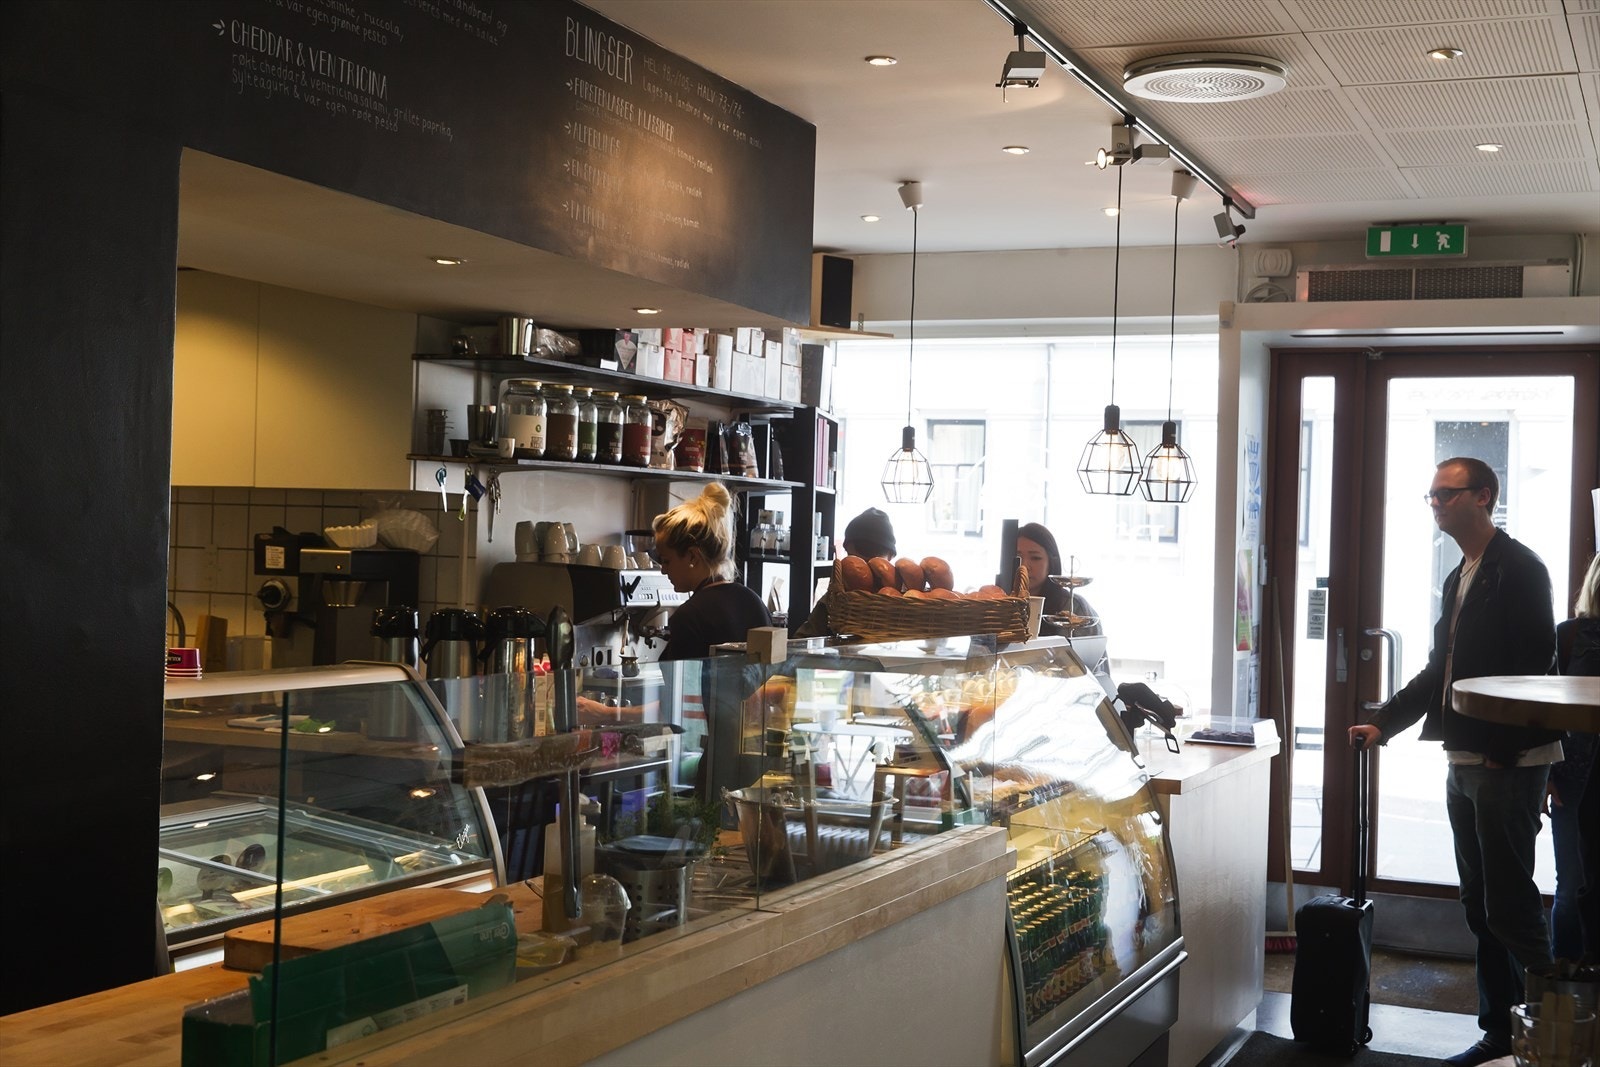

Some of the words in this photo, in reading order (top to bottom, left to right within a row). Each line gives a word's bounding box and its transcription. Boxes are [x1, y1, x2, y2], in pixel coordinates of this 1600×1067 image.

[231, 19, 294, 65] CHEDDAR
[296, 42, 307, 68] &
[306, 5, 330, 26] egen
[362, 27, 388, 46] pesto
[259, 59, 300, 83] cheddar
[565, 16, 634, 85] BLINGSER
[325, 98, 347, 118] egen
[375, 114, 399, 133] pesto
